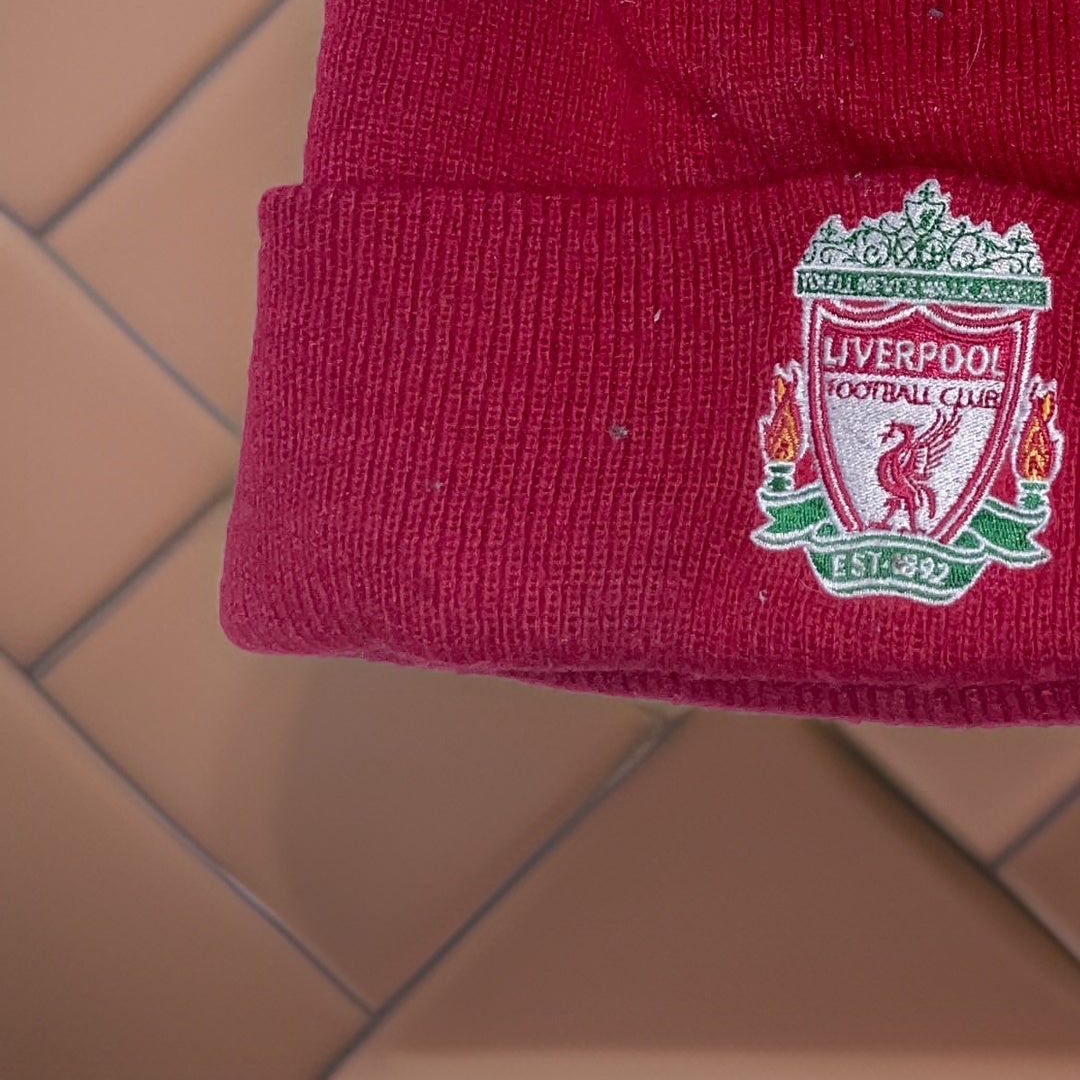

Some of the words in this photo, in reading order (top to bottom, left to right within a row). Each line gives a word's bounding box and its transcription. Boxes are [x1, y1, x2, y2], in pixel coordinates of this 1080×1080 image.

[823, 336, 1005, 376] LIVERPOOL
[826, 379, 932, 405] FOOTBALL
[940, 386, 1002, 408] CLUB
